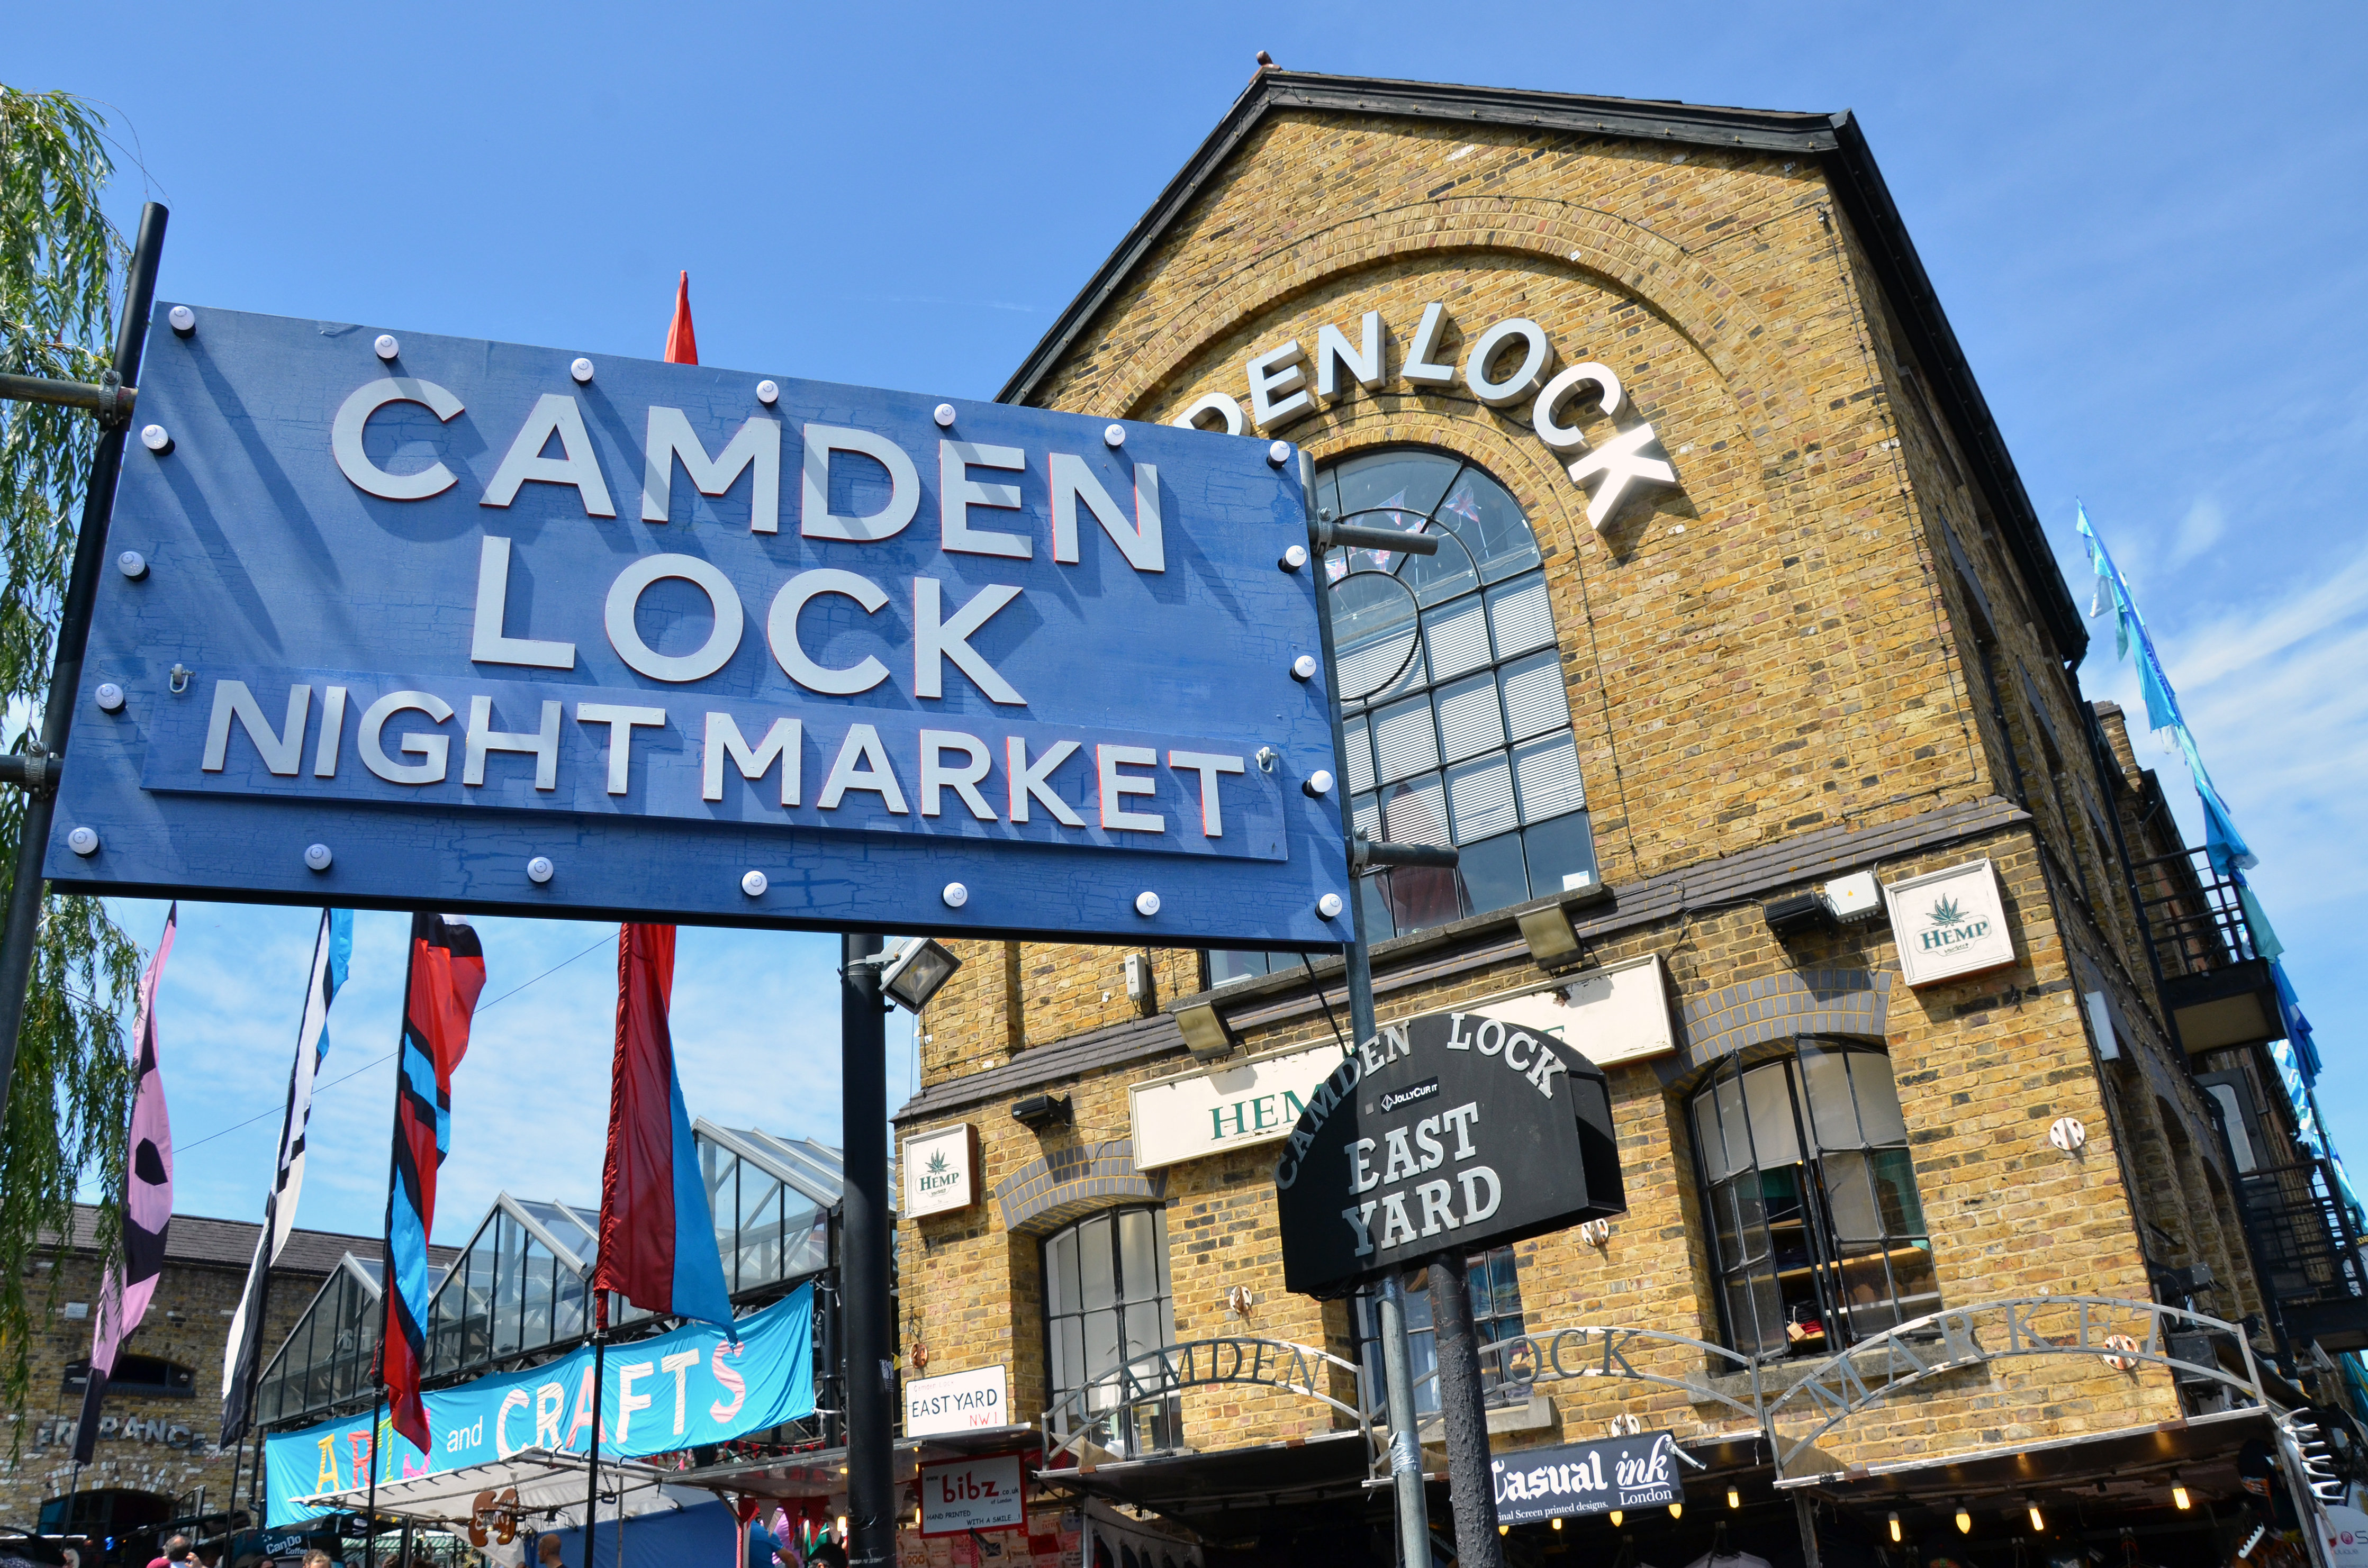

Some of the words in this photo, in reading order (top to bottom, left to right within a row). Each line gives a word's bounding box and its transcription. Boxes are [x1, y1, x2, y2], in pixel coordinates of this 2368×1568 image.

[1402, 302, 1678, 531] LOCK
[332, 377, 1165, 572] CAMDEN
[471, 534, 1027, 705] LOCK
[202, 679, 665, 795] NIGHT
[703, 711, 1244, 837] MARKET
[1920, 921, 1988, 950] HEMP
[1208, 1083, 1324, 1141] HEM
[1275, 1020, 1411, 1190] CAMDEN
[1447, 1013, 1568, 1100] LOCK
[1344, 1102, 1479, 1196] EAST
[920, 1172, 959, 1191] HEMP
[1342, 1166, 1502, 1257] YARD
[1077, 1337, 1326, 1424] CAMDEN
[1483, 1328, 1644, 1396] OCK
[1800, 1297, 2182, 1428] MARKET
[446, 1416, 483, 1453] and
[495, 1339, 745, 1461] CRAFTS
[912, 1395, 951, 1418] EAST
[953, 1389, 997, 1411] YARD
[33, 1416, 208, 1455] ENRANCE
[1615, 1434, 1673, 1487] ink
[942, 1470, 999, 1503] bibz
[945, 1510, 971, 1518] PRINTED
[1497, 1512, 1514, 1524] inal
[1515, 1508, 1543, 1519] Screen
[1545, 1502, 1575, 1518] printed
[1576, 1500, 1608, 1512] designs.
[1619, 1488, 1673, 1506] London
[266, 1536, 302, 1555] CanDo
